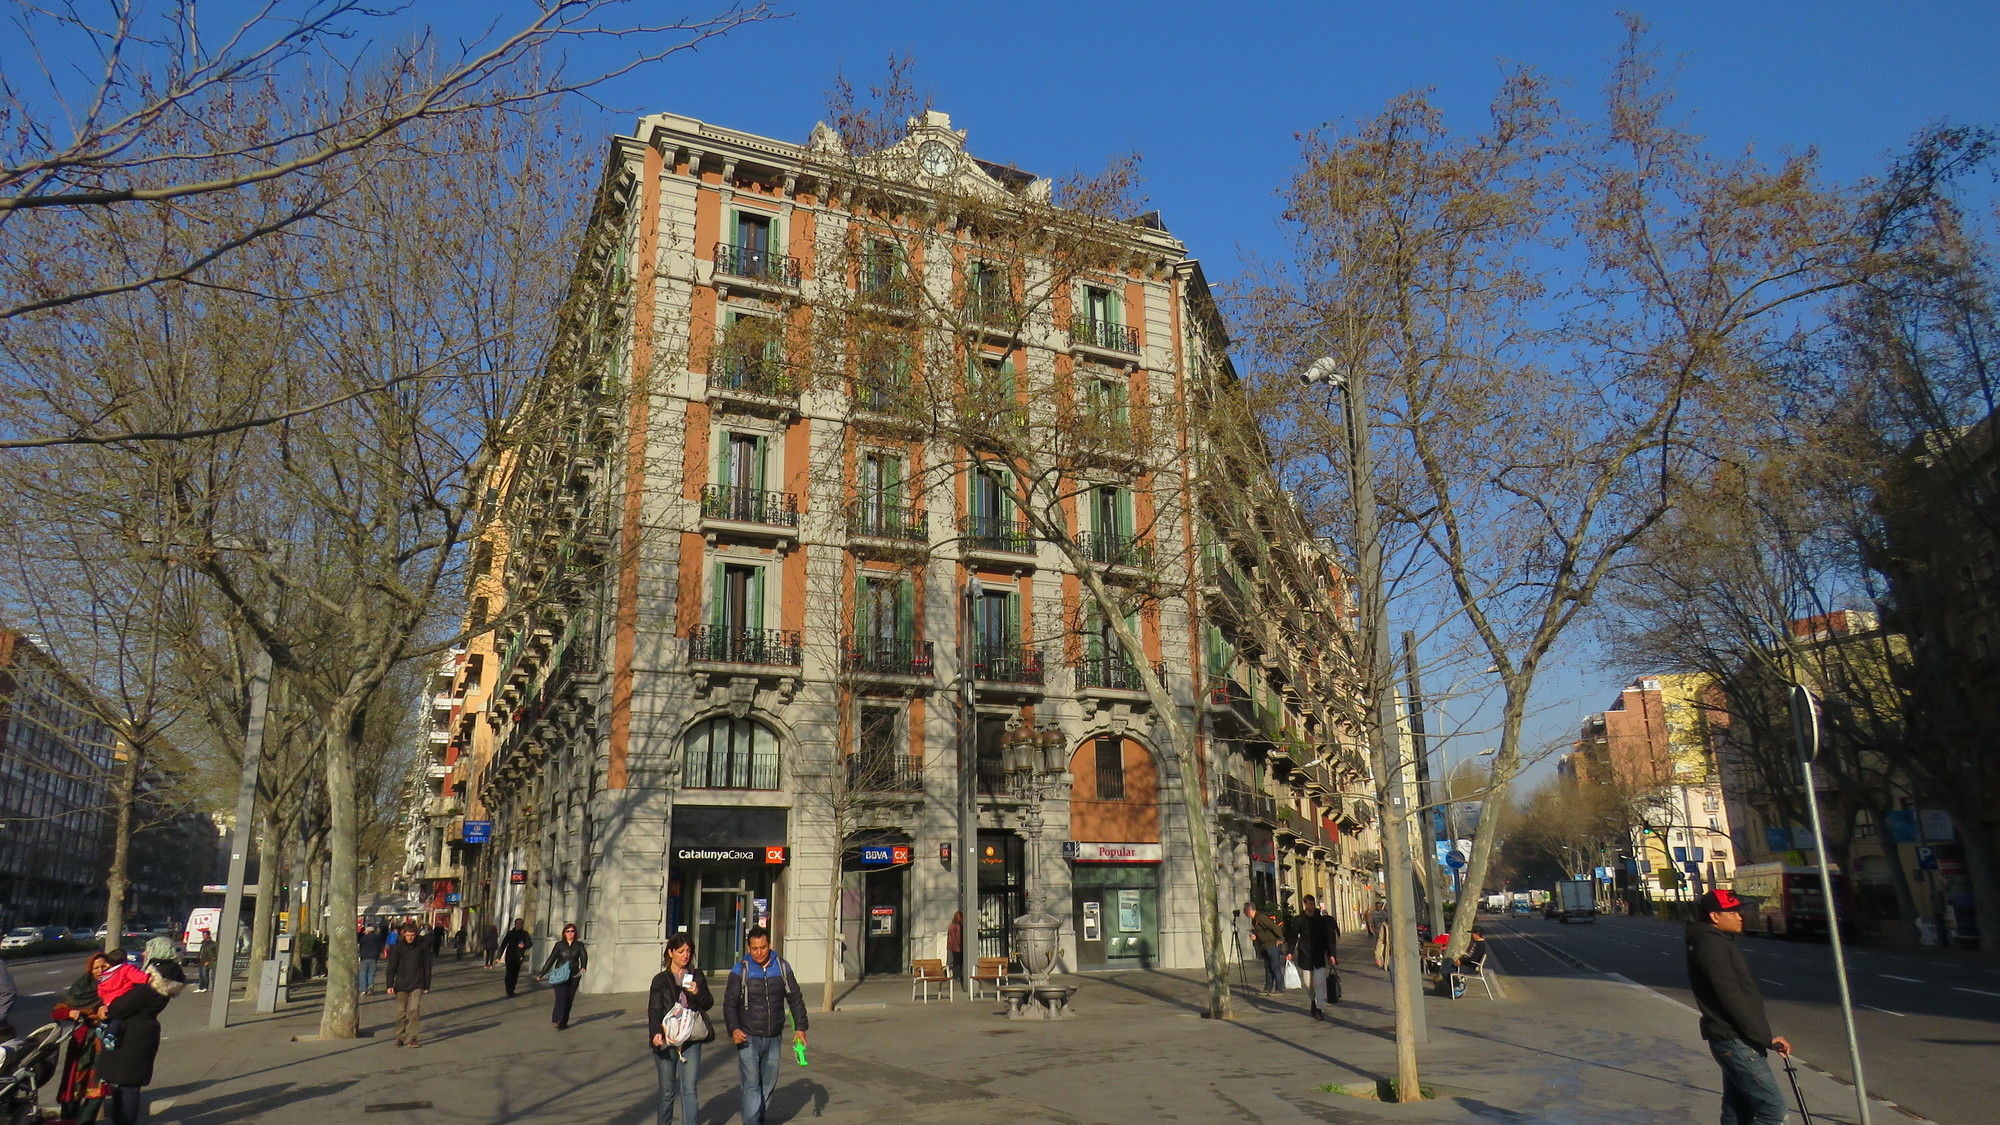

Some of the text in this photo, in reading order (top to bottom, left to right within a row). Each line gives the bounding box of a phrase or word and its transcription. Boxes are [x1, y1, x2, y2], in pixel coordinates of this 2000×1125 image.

[678, 849, 754, 861] CatalunyaCaixa
[767, 850, 786, 861] CX
[865, 850, 888, 860] BBVA
[894, 850, 907, 860] CX
[1098, 846, 1136, 858] Popular
[1918, 847, 1931, 861] P
